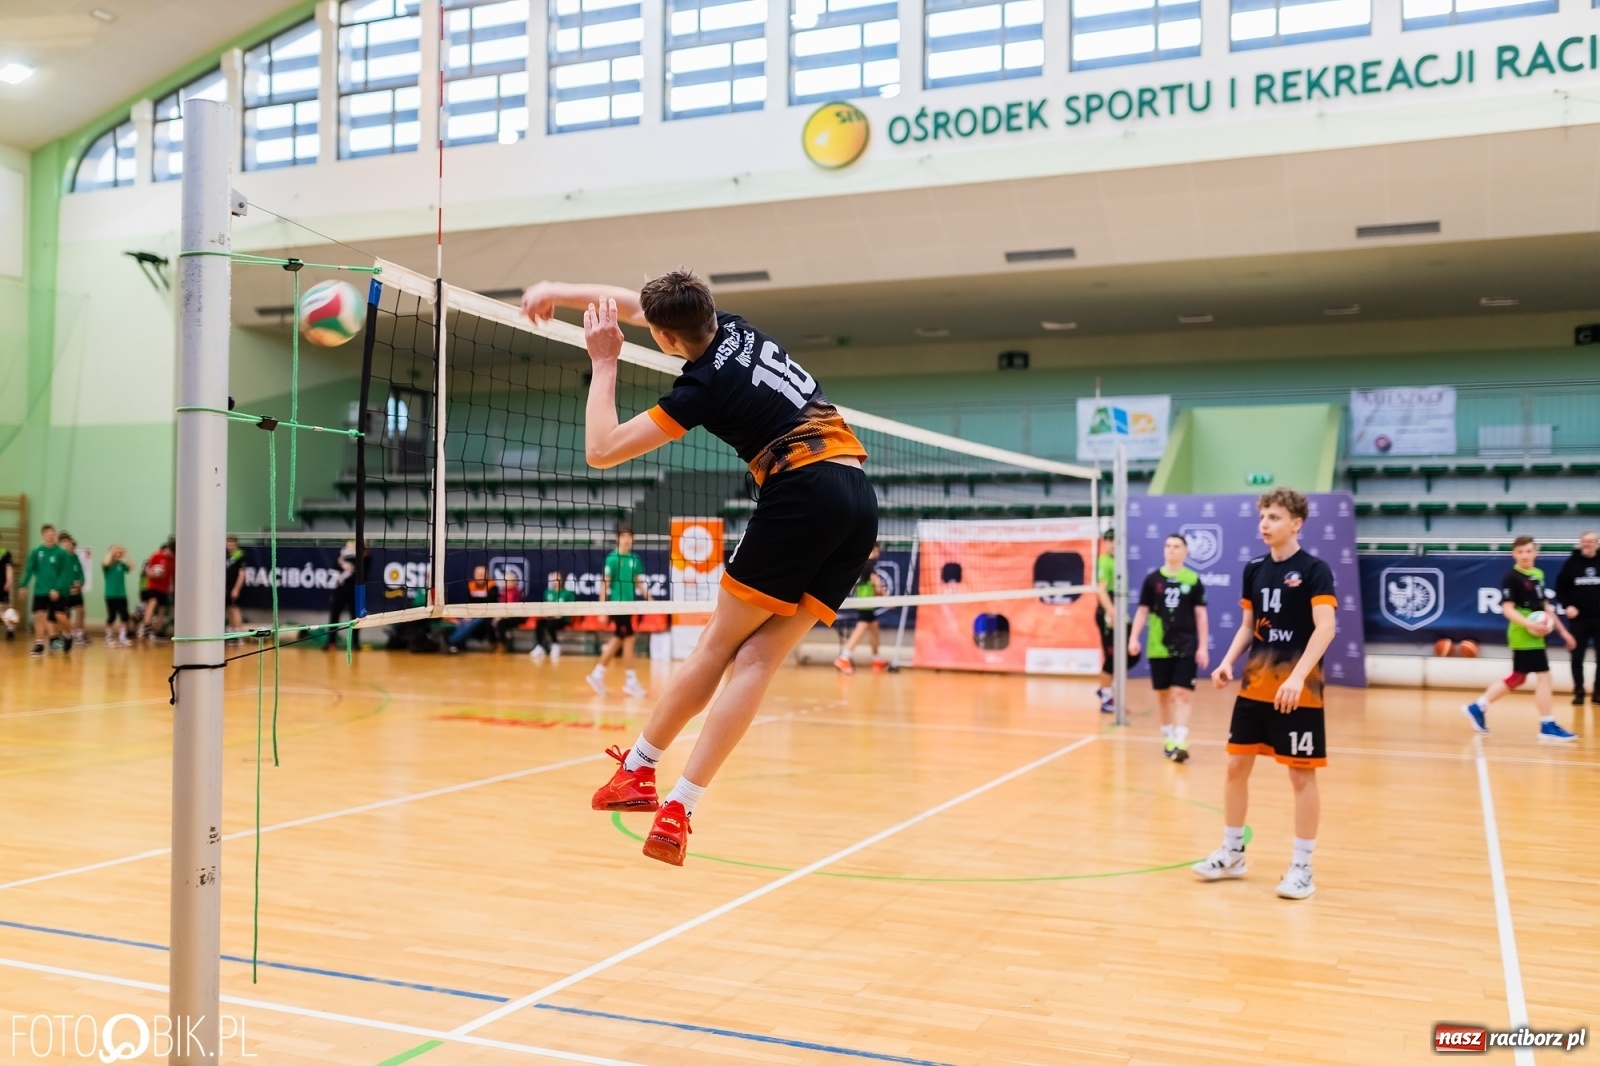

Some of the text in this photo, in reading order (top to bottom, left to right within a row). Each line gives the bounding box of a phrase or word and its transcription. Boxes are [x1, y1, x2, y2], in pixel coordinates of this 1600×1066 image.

[888, 34, 1598, 145] OŚRODEK SPORTU I REKREACJI RACI
[751, 340, 817, 410] 16
[1260, 587, 1282, 613] 14
[1288, 731, 1315, 756] 14
